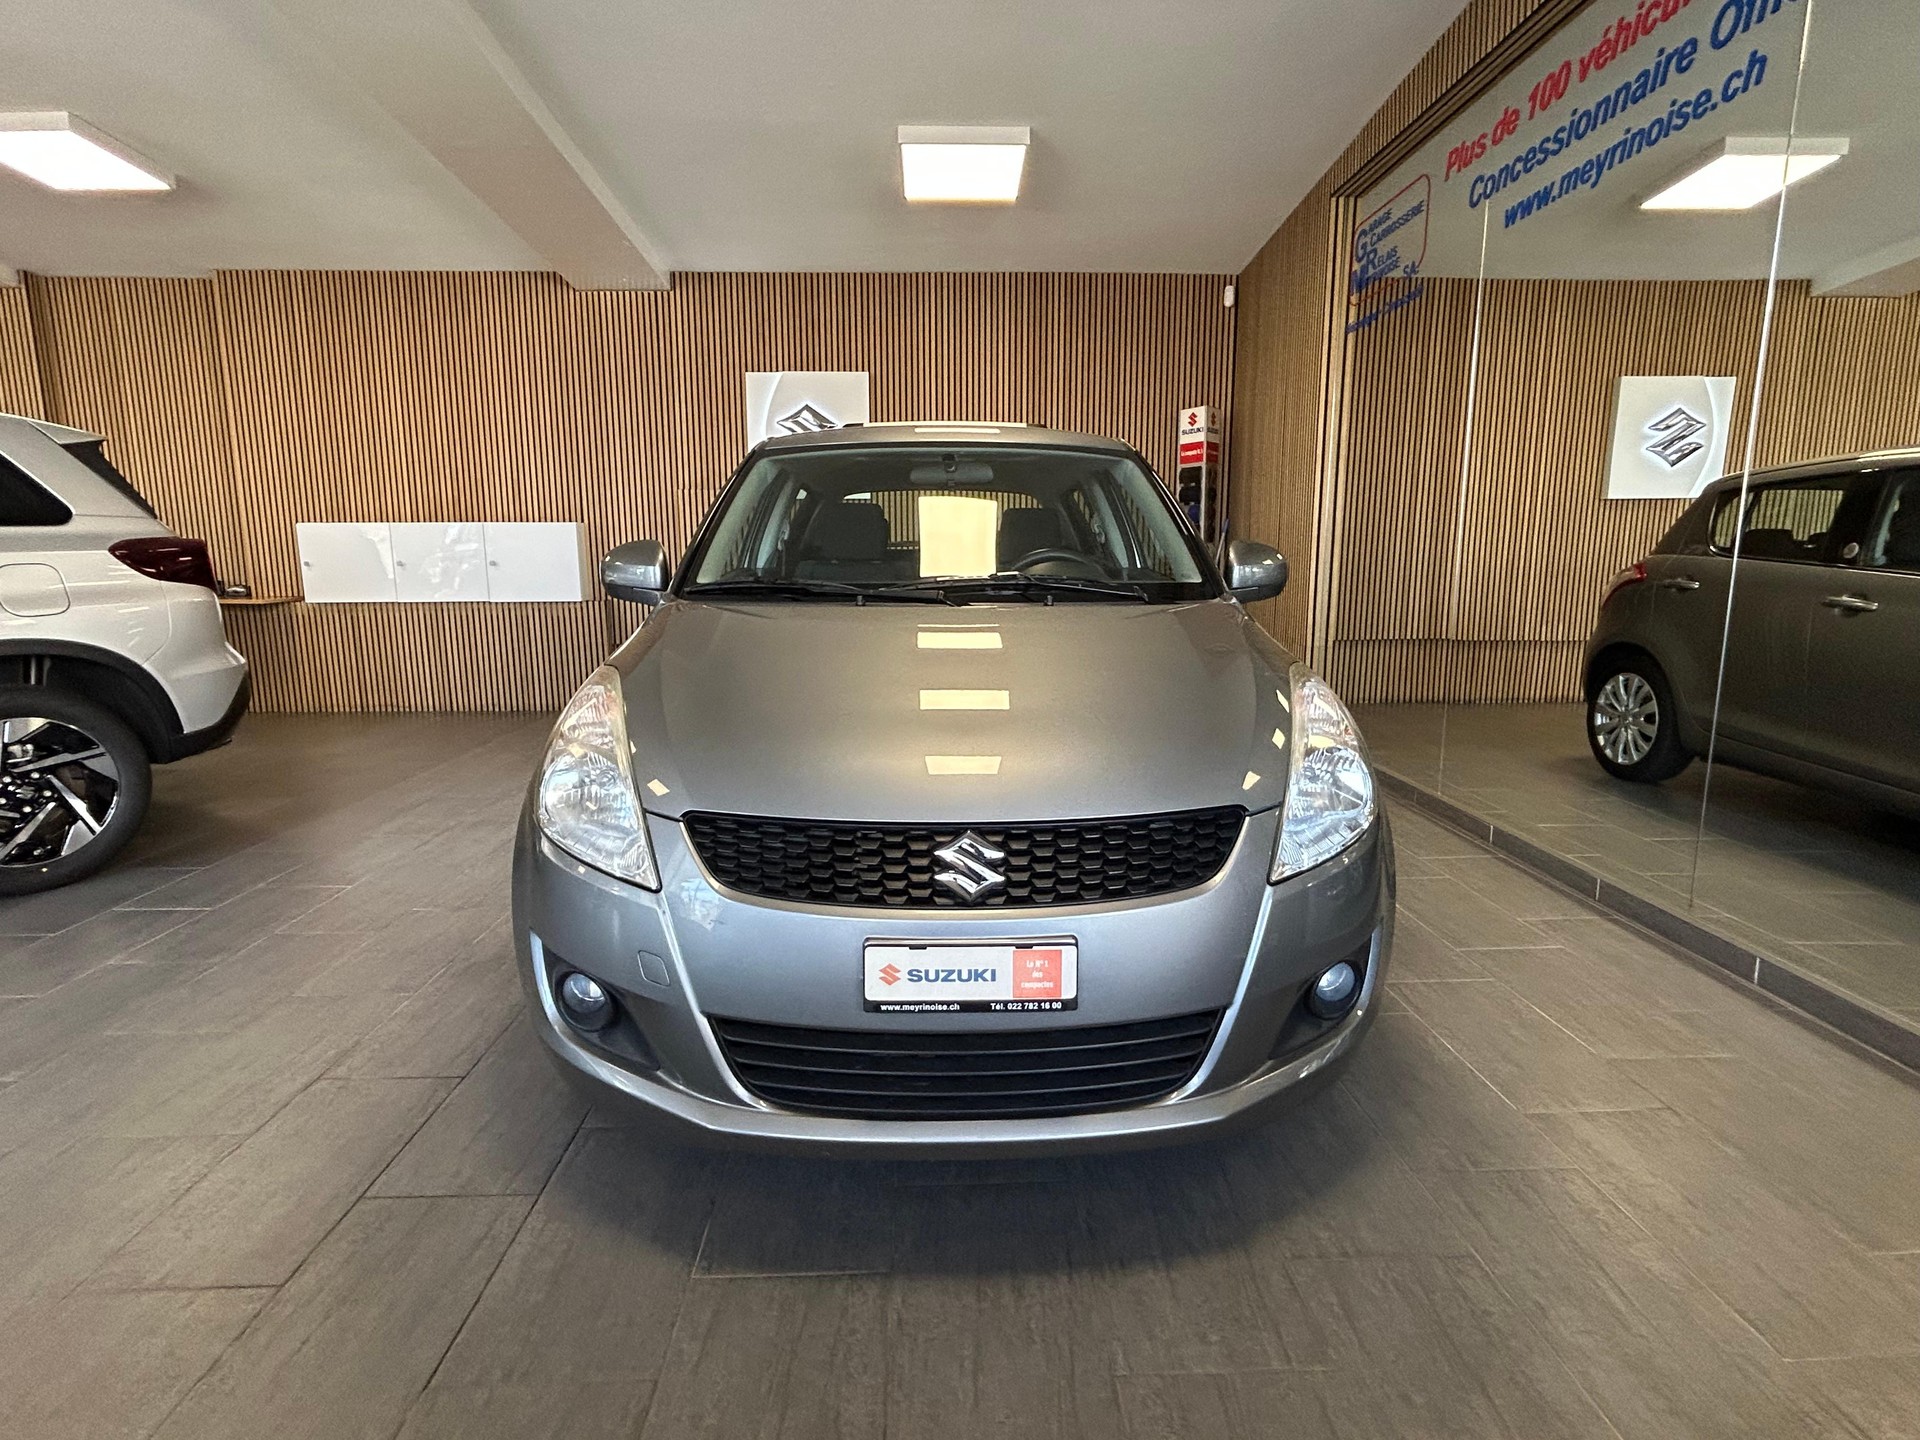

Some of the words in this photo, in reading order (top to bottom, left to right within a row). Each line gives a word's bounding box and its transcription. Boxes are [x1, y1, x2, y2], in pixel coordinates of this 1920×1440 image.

[1444, 132, 1488, 182] Plus
[1491, 105, 1521, 146] de
[1528, 60, 1572, 120] 100
[1469, 37, 1699, 208] Concessionnaire
[1504, 49, 1768, 229] www.meyrinoise.ch
[1181, 427, 1204, 435] SUZUKI
[907, 968, 997, 983] SUZUKI
[880, 1003, 960, 1012] www.meyrinoise.ch
[990, 1002, 1006, 1011] Tél.
[1007, 1002, 1022, 1010] 022
[1023, 1002, 1039, 1010] 782
[1040, 1001, 1051, 1009] 16
[1051, 1001, 1062, 1009] 00
